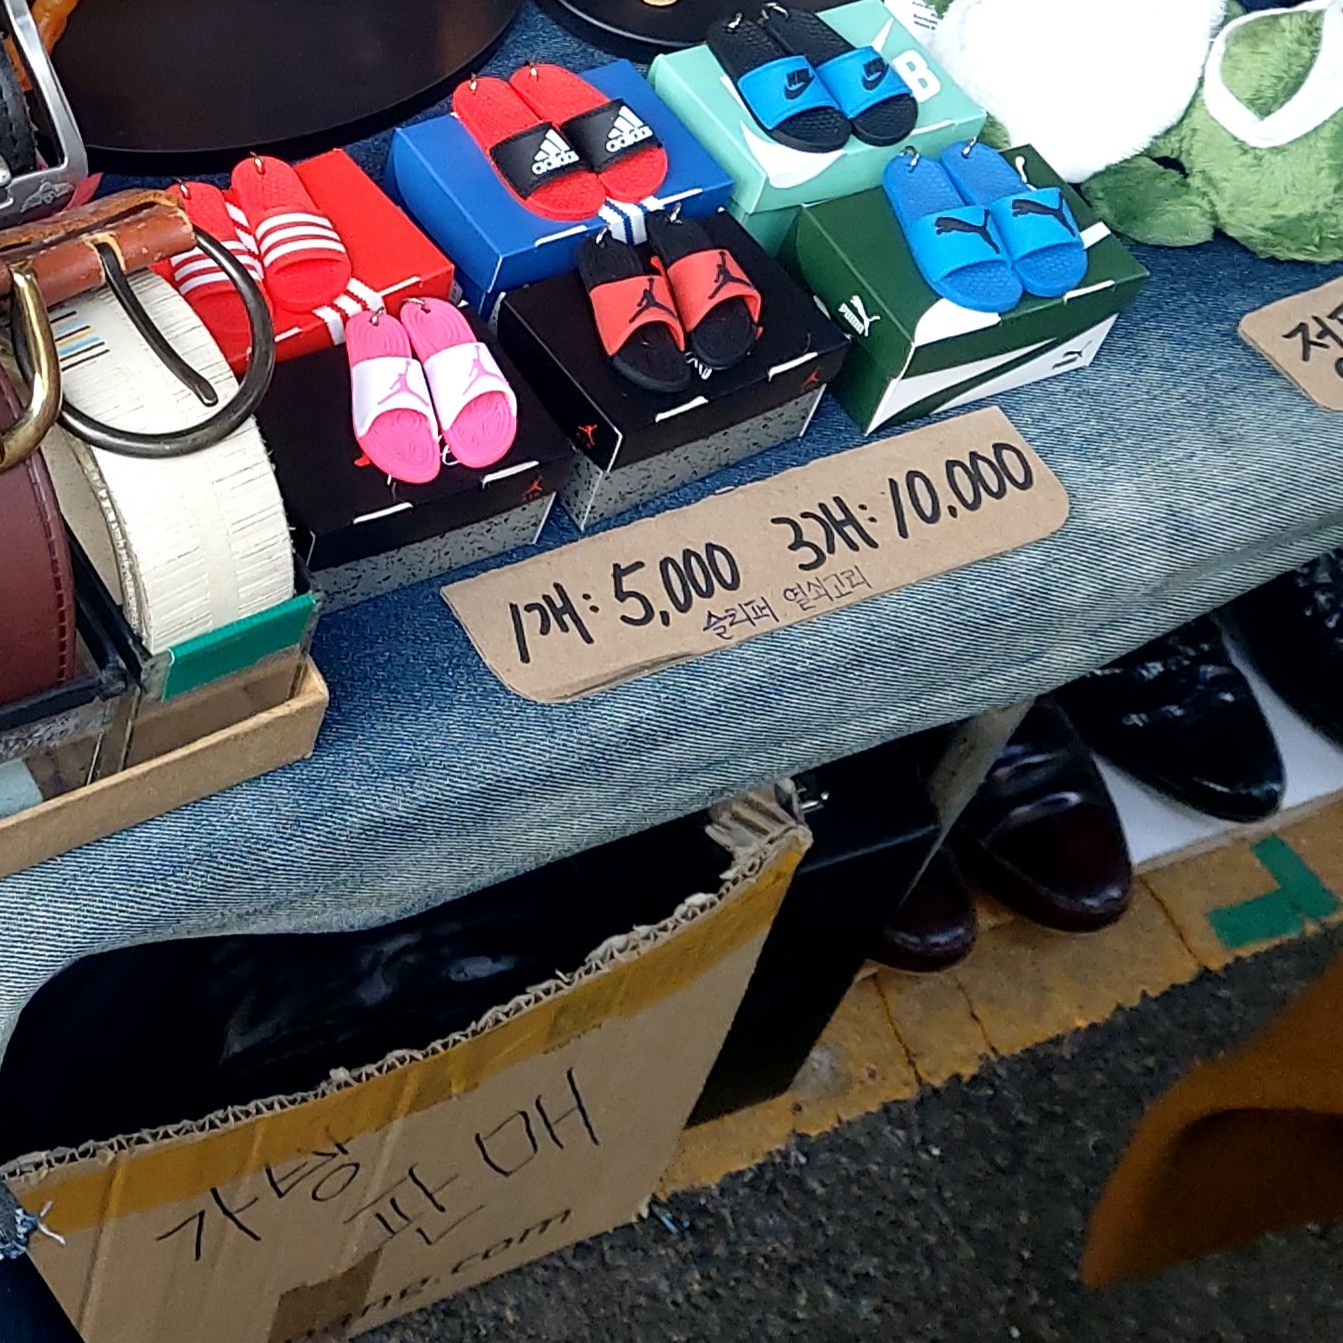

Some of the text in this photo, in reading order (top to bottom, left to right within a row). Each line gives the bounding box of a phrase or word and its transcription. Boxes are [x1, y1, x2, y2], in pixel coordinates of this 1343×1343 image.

[611, 542, 740, 628] 5,000
[703, 565, 873, 641] 슬리퍼 열쇠고리
